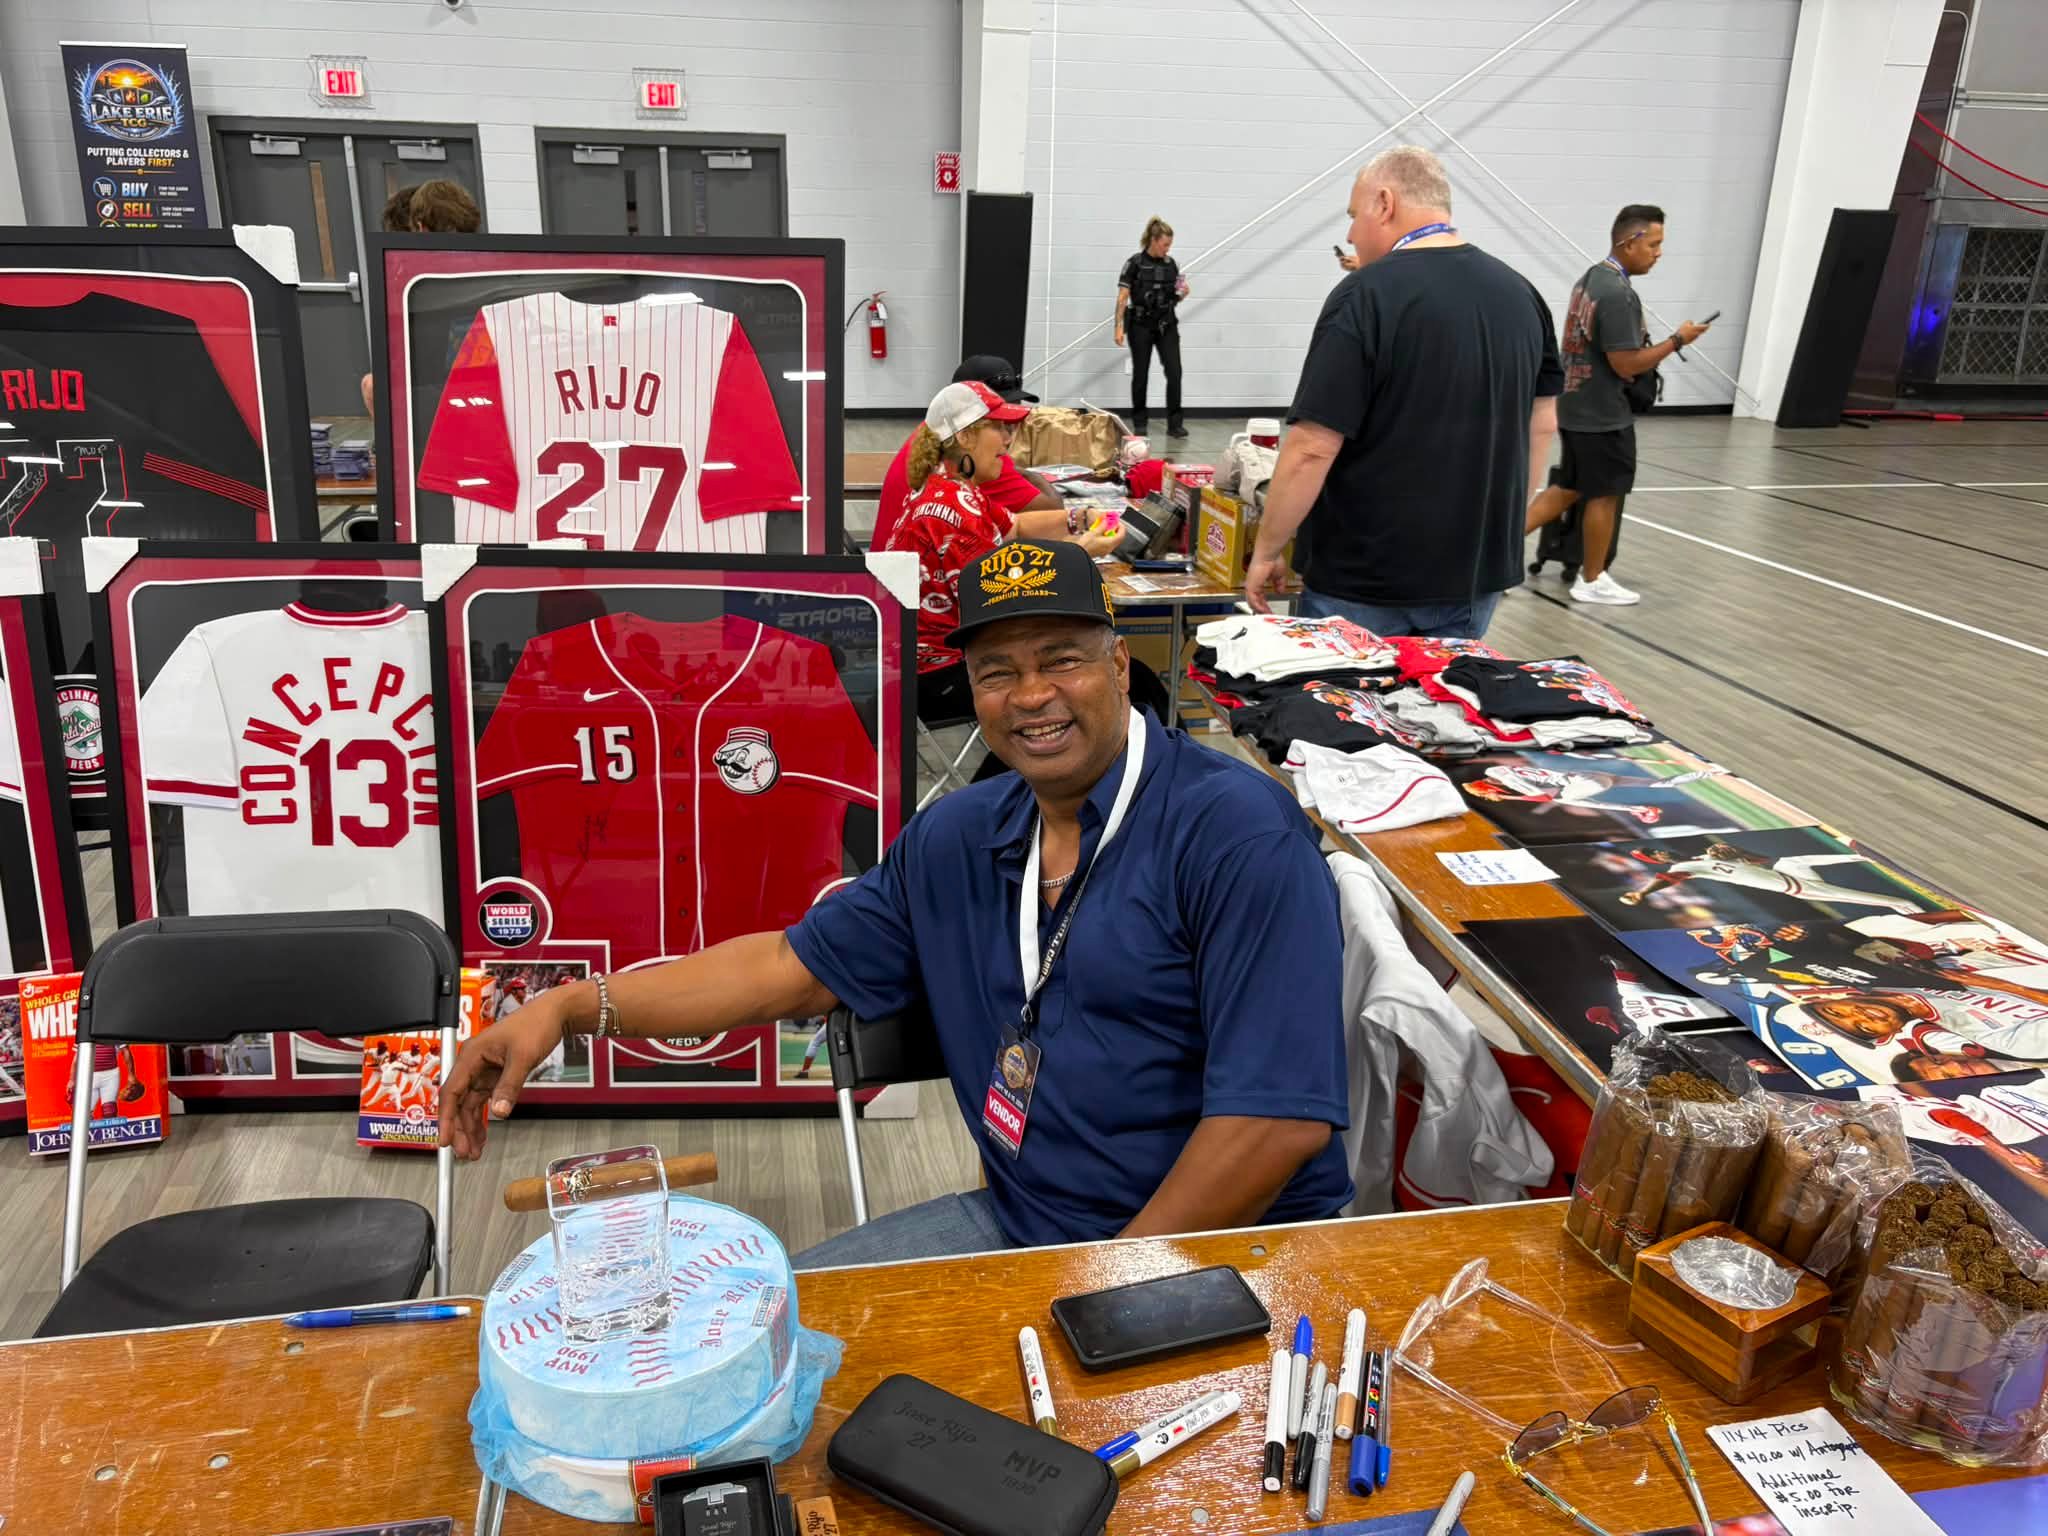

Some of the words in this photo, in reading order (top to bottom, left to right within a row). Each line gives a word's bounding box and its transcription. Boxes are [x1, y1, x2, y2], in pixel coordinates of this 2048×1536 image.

[326, 69, 357, 94] EXIT
[648, 83, 676, 106] EXIT
[91, 103, 133, 121] LAKE
[135, 105, 174, 121] ERIE
[121, 118, 147, 128] TCG
[87, 147, 125, 157] PUTTING
[127, 148, 181, 158] COLLECTORS
[182, 149, 189, 158] &
[106, 157, 146, 167] PLAYERS
[148, 158, 175, 167] FIRST.
[122, 182, 149, 197] BUY
[123, 202, 153, 218] SELL
[2, 368, 86, 412] RIJO
[554, 364, 662, 418] RIJO
[536, 437, 688, 552] 27
[911, 501, 963, 529] CINCINNATI
[979, 550, 1026, 578] RIJO
[1029, 550, 1055, 567] 27
[1021, 588, 1049, 598] CIGARS
[57, 689, 100, 706] CINNA
[573, 725, 637, 785] 15
[299, 738, 411, 849] 13
[490, 906, 527, 916] WORLD
[491, 917, 528, 926] SERIES
[25, 993, 61, 1010] WHOLE
[1625, 999, 1649, 1020] RIJO
[1642, 995, 1695, 1018] 27
[27, 1000, 78, 1040] WHE
[987, 1096, 1022, 1136] VENDOR
[32, 1127, 98, 1152] JOHNY
[102, 1119, 157, 1139] BENCH
[369, 1121, 403, 1135] WORLD
[556, 1346, 599, 1363] 1990
[544, 1357, 590, 1376] MVP
[893, 1401, 937, 1427] Jose
[939, 1418, 978, 1445] Rijo
[1768, 1422, 1809, 1437] Pics
[905, 1432, 937, 1449] 27
[1733, 1450, 1784, 1464] $40.00
[1788, 1446, 1805, 1461] w/
[1002, 1450, 1063, 1482] MVP
[1757, 1469, 1843, 1490] Additional
[1774, 1489, 1822, 1504] $5.00
